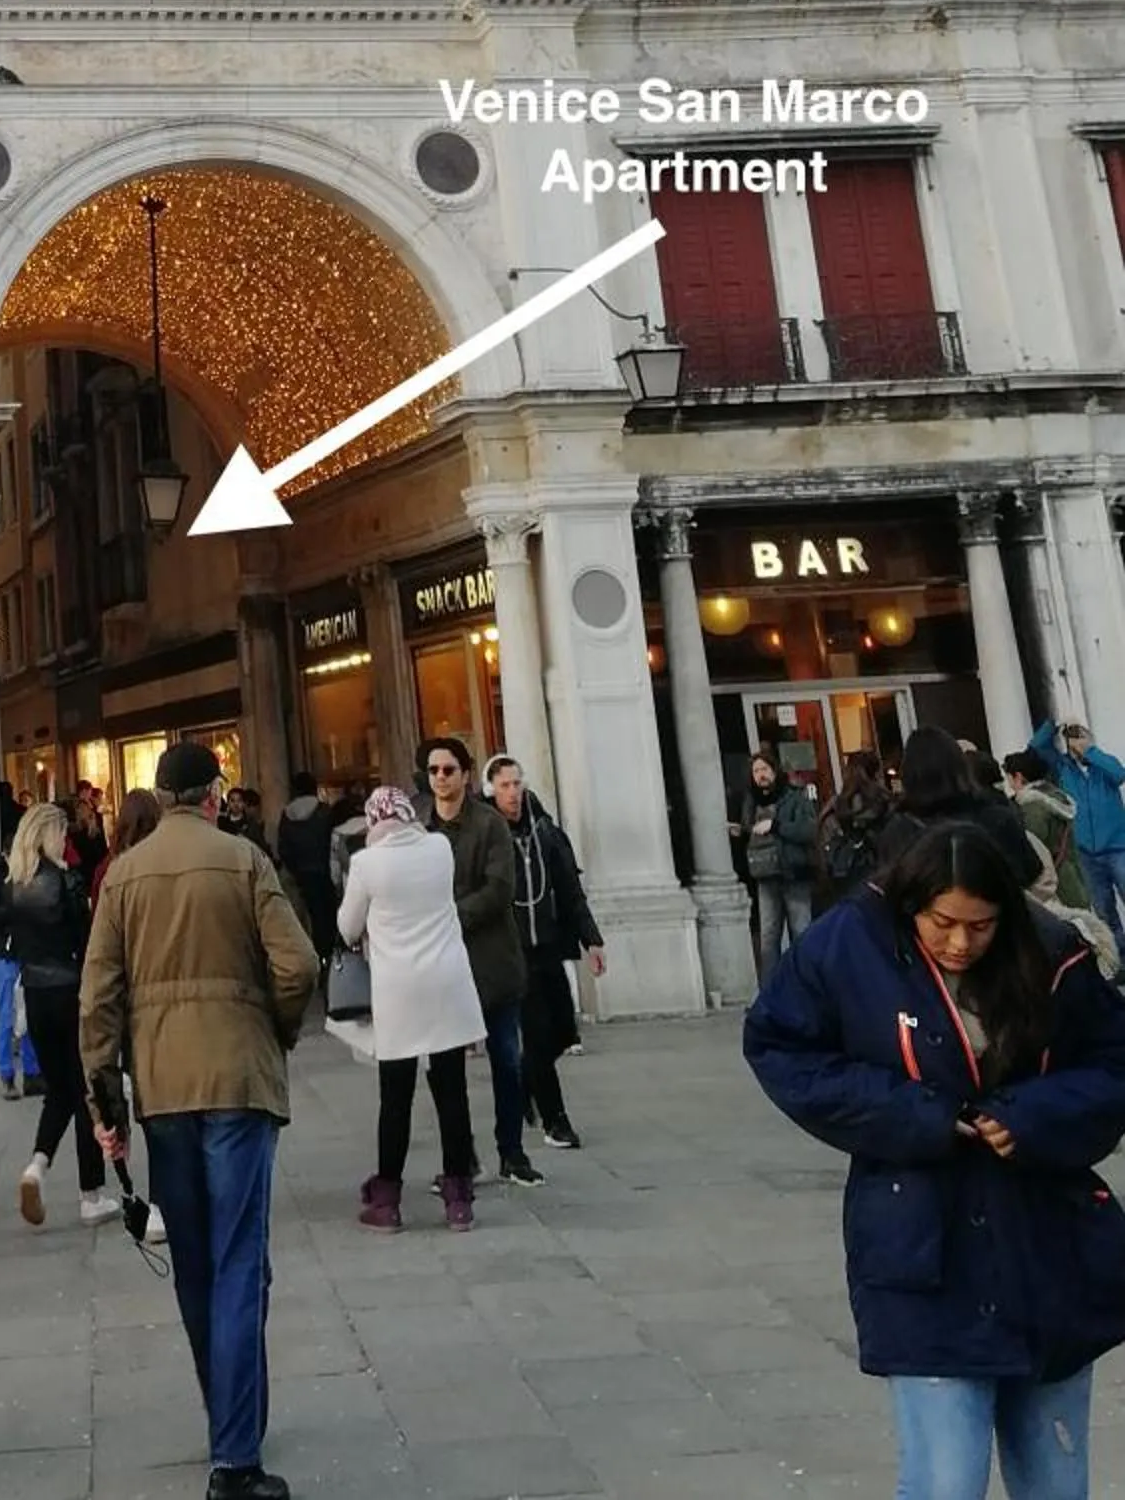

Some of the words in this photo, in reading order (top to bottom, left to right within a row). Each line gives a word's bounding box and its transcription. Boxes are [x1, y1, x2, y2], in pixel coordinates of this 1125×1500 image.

[751, 537, 869, 578] BAR
[416, 578, 465, 616] SNACK
[465, 569, 496, 609] BAR
